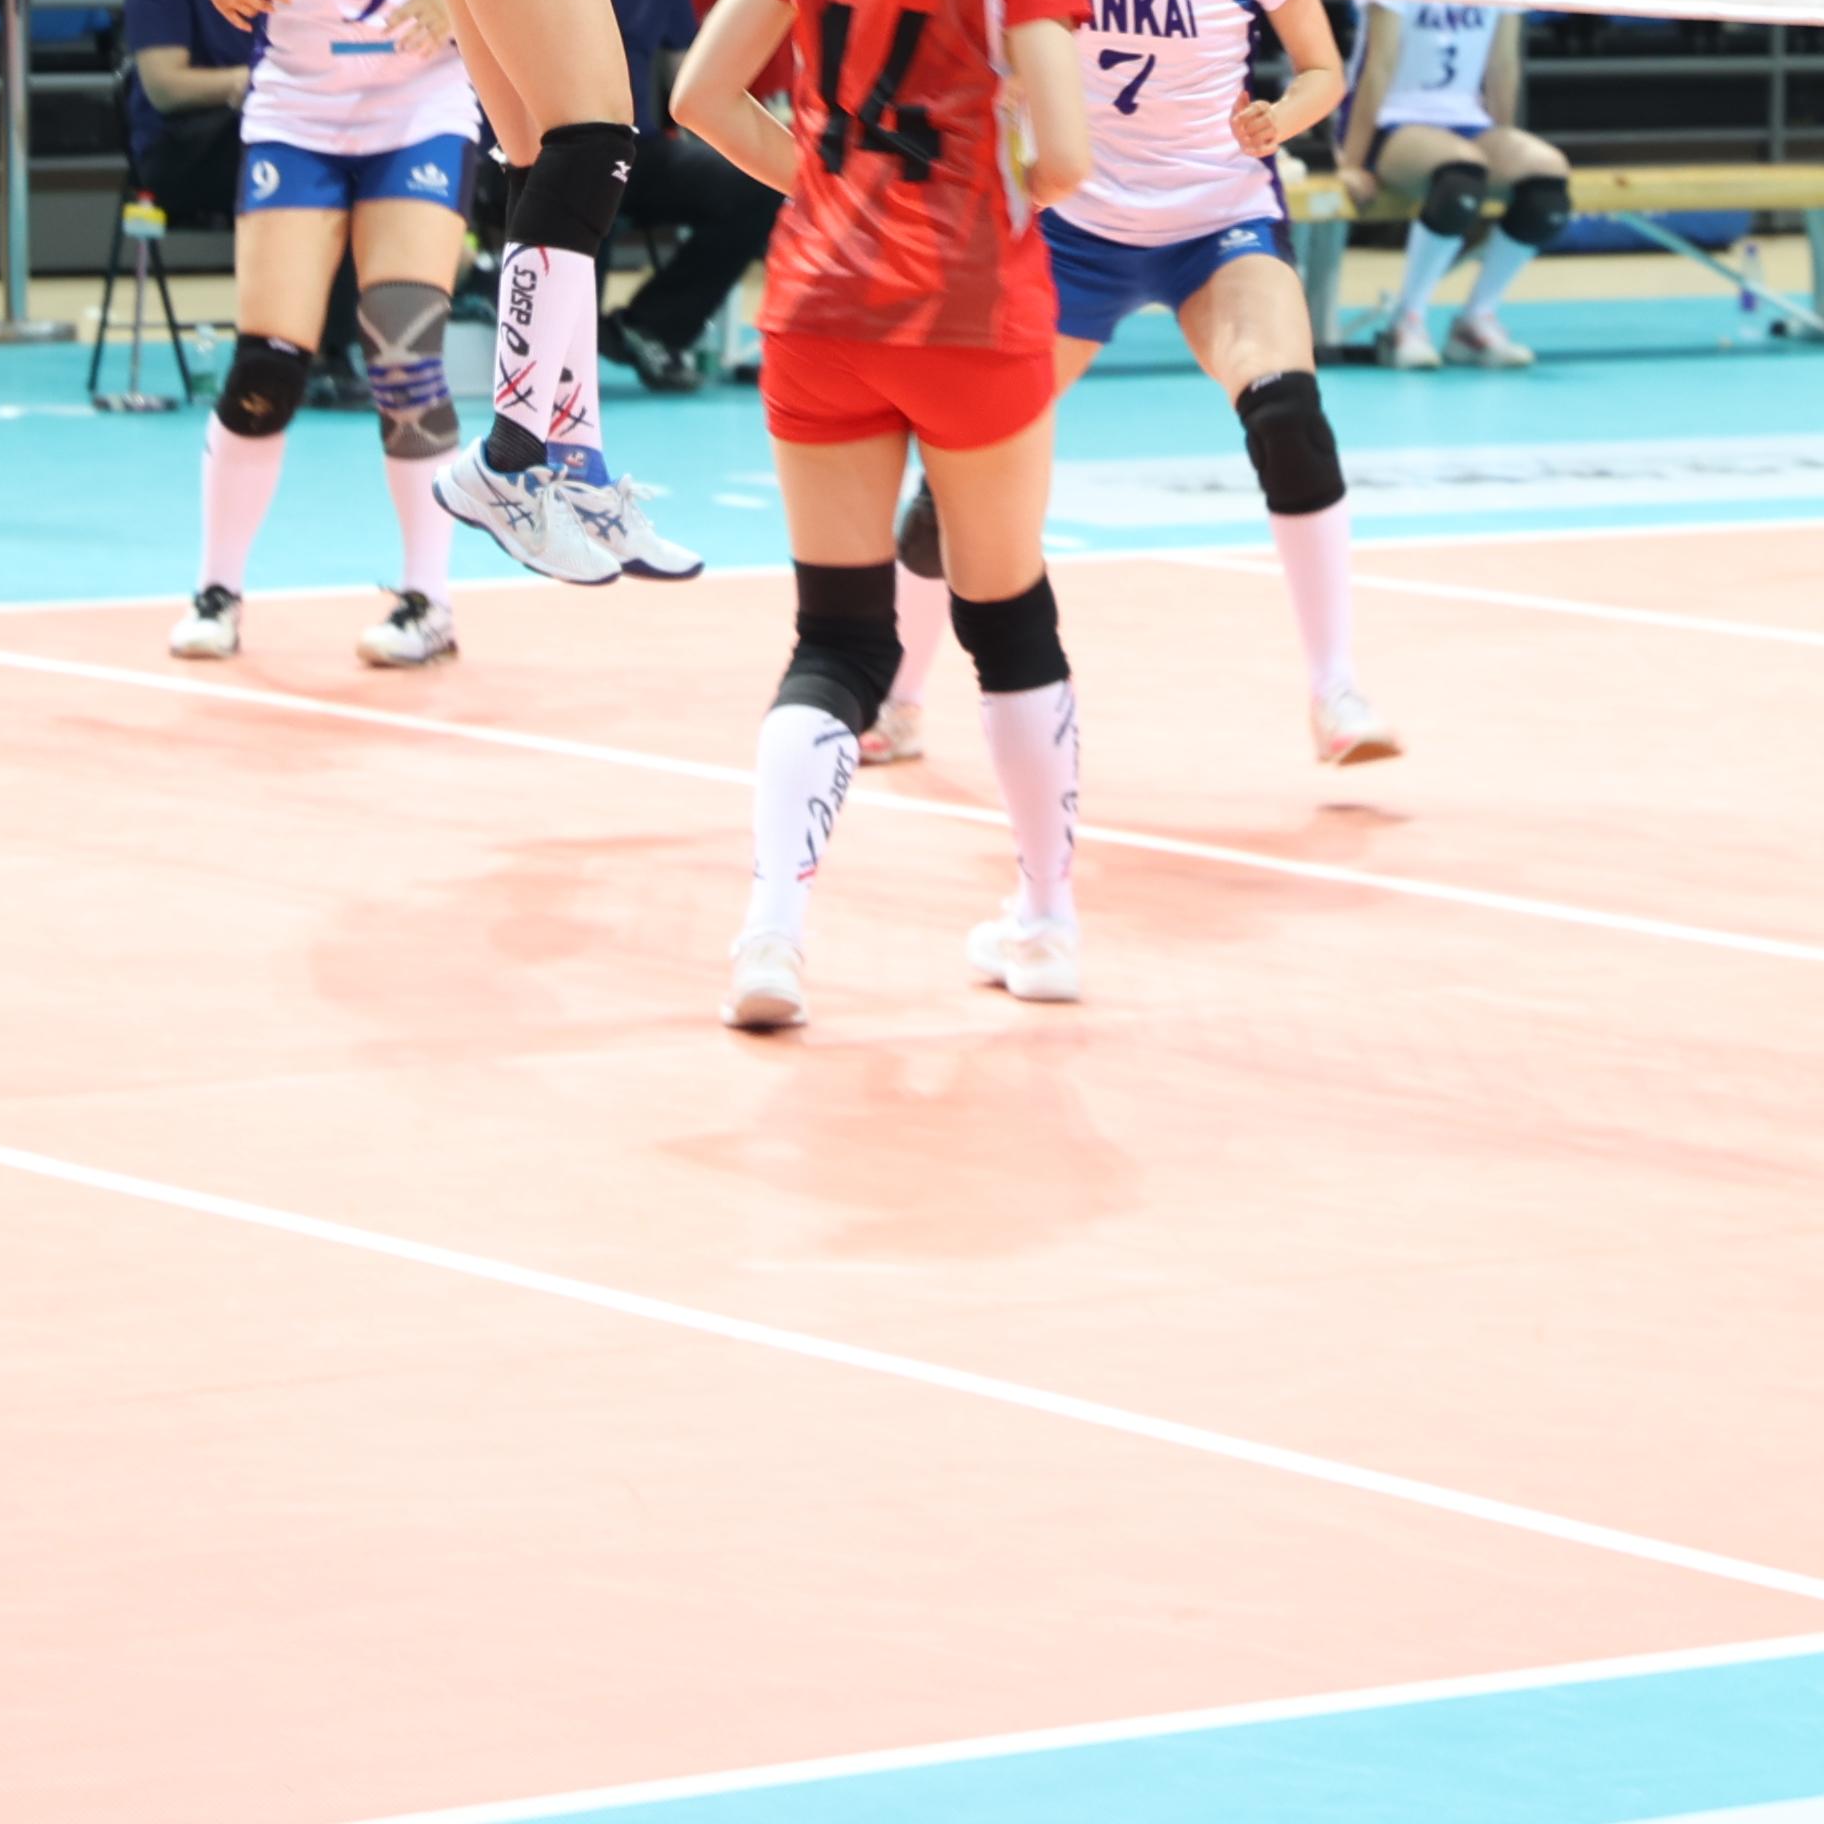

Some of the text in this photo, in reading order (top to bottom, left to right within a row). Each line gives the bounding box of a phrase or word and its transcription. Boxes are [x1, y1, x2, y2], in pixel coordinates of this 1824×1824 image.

[820, 0, 943, 182] 14
[1098, 48, 1155, 115] 7
[251, 160, 281, 201] 9
